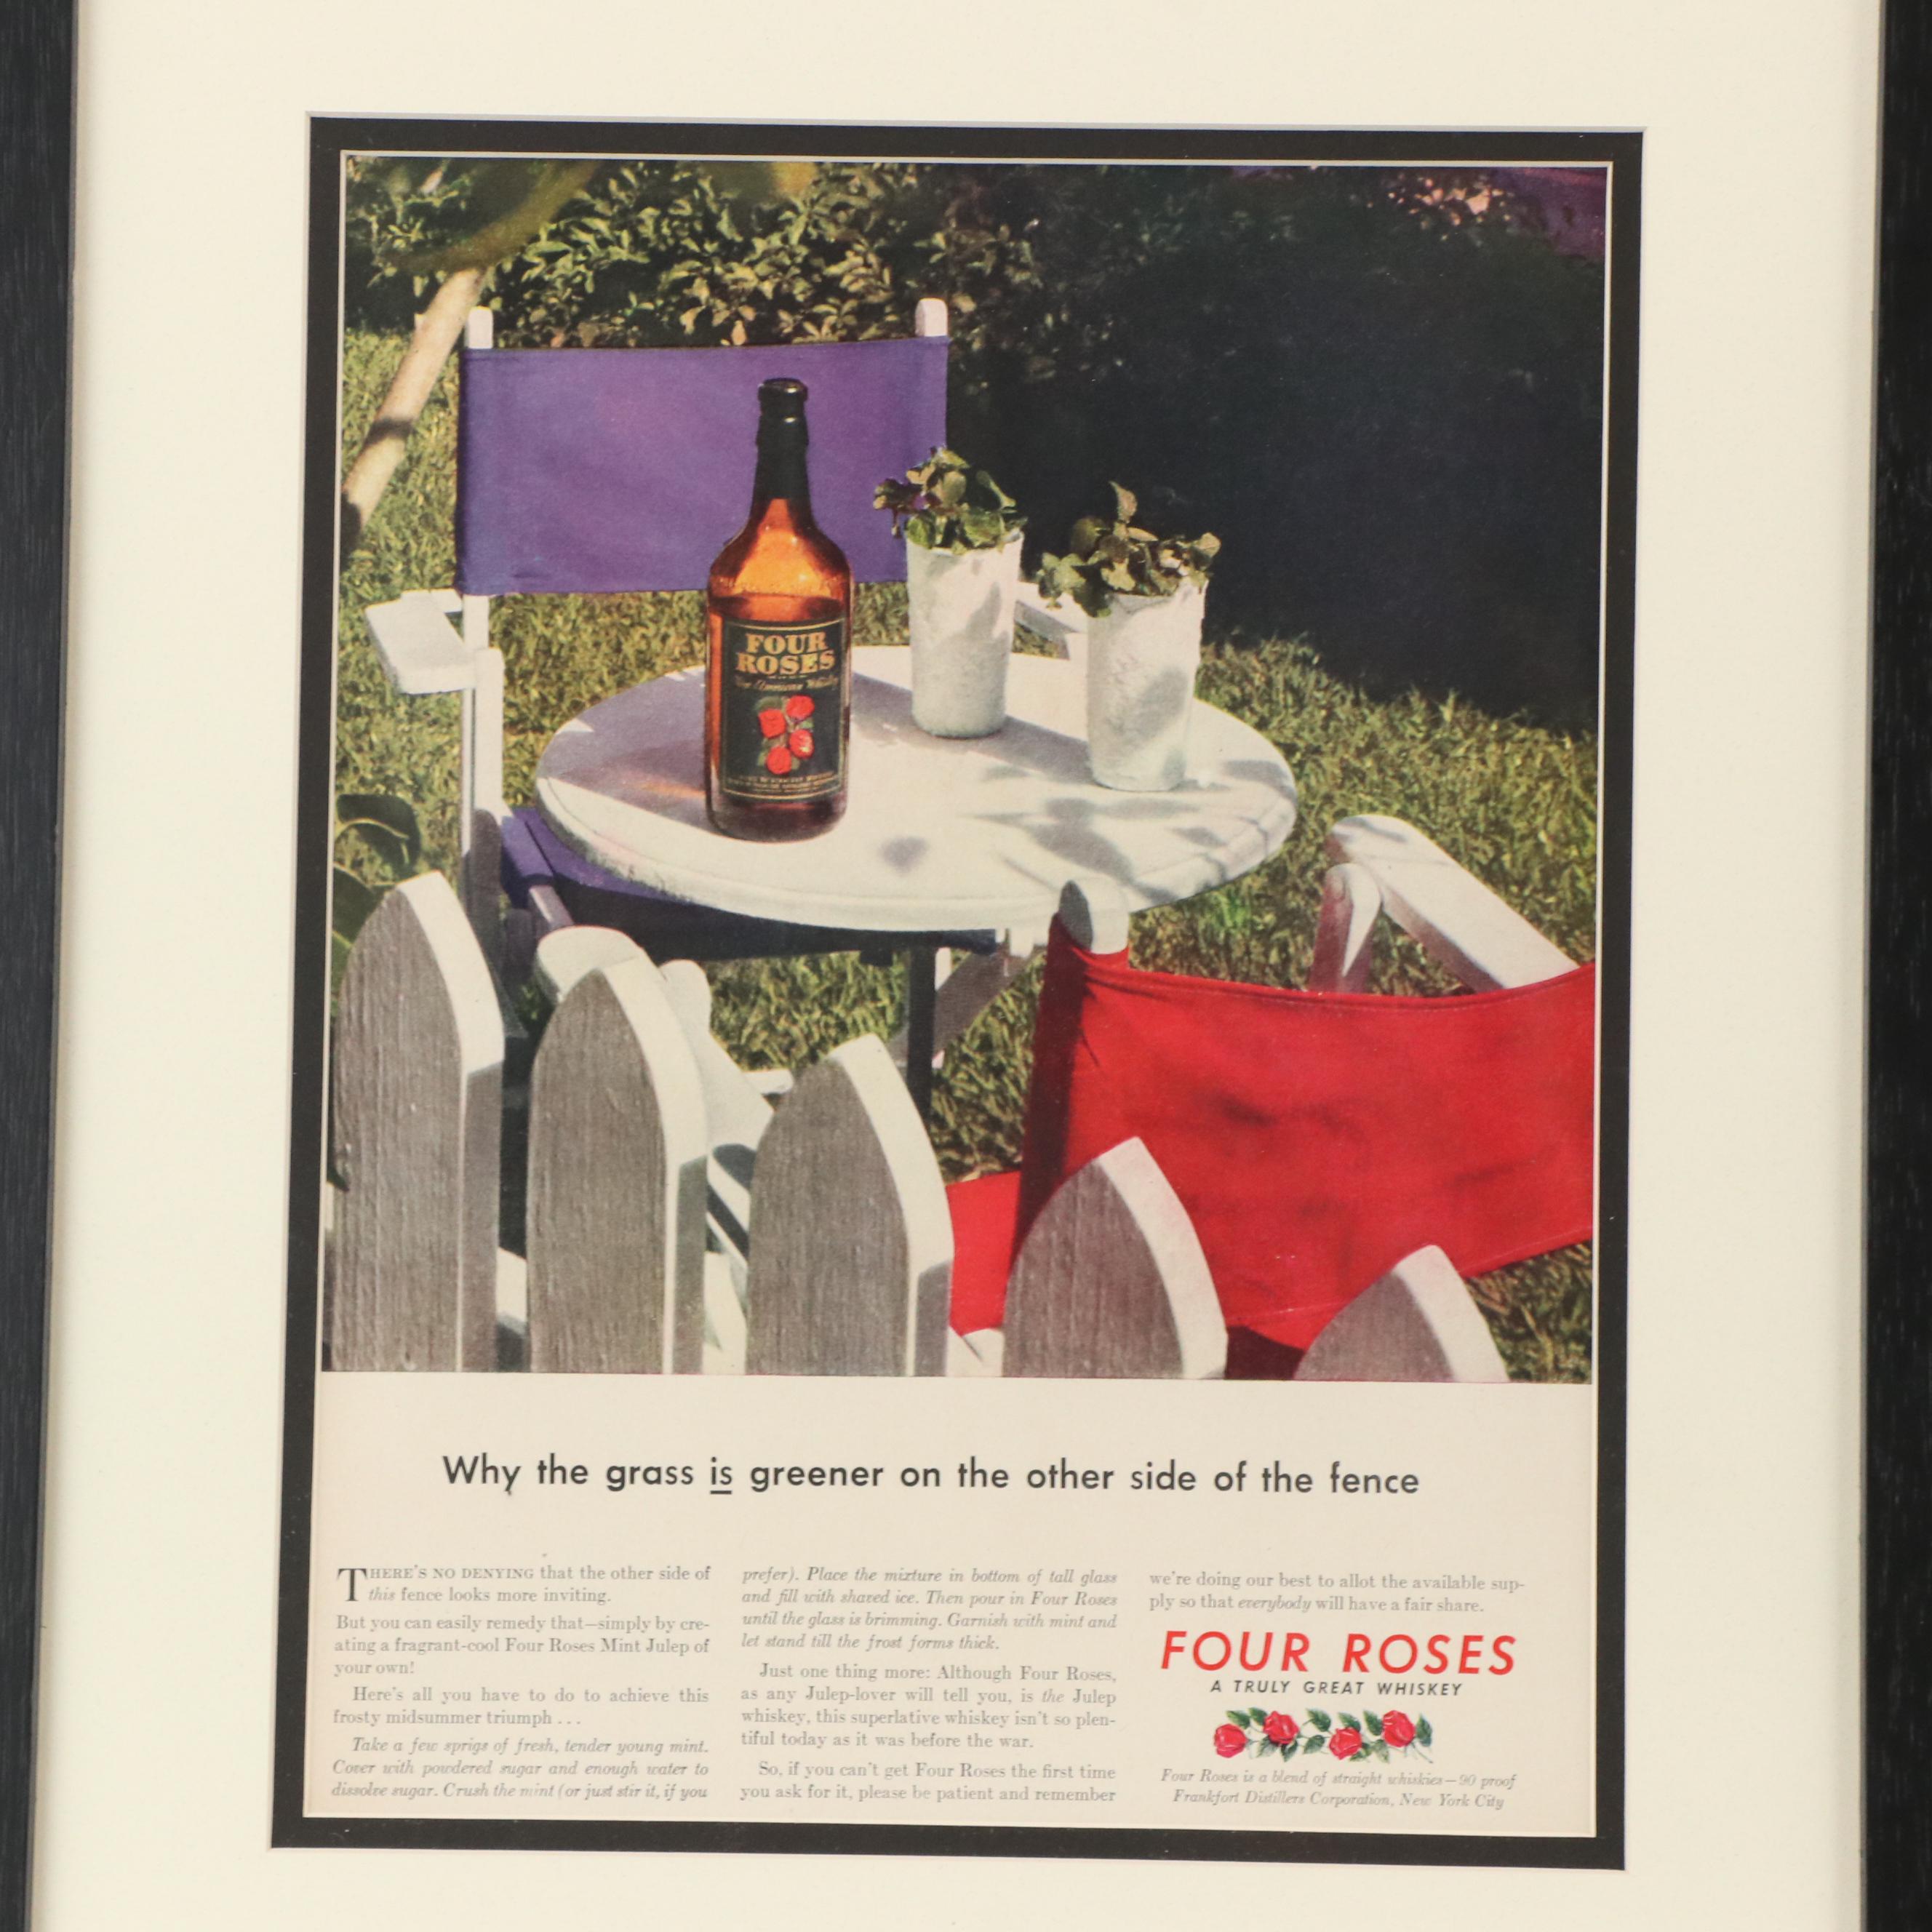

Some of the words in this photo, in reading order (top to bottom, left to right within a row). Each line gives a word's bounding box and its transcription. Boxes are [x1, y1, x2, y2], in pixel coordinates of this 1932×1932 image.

[746, 631, 828, 654] FOUR
[736, 650, 835, 675] ROSES
[442, 1452, 522, 1495] Why
[537, 1452, 589, 1485] the
[606, 1465, 694, 1493] grass
[709, 1456, 733, 1496] is
[749, 1466, 884, 1493] greener
[900, 1467, 941, 1488] on
[957, 1455, 1010, 1489] the
[1026, 1457, 1114, 1490] other
[1130, 1458, 1197, 1491] side
[1213, 1460, 1248, 1492] of
[1261, 1460, 1313, 1493] the
[1329, 1461, 1419, 1494] fence
[432, 1568, 456, 1579] NO
[461, 1568, 534, 1579] DENYING
[540, 1565, 573, 1579] that
[579, 1565, 606, 1580] the
[610, 1565, 654, 1580] other
[658, 1565, 690, 1581] side
[806, 1566, 848, 1581] Place
[854, 1566, 877, 1581] the
[971, 1568, 1020, 1583] bottom
[1049, 1568, 1074, 1584] tall
[1079, 1569, 1118, 1587] glass
[1149, 1570, 1191, 1586] we're
[1196, 1570, 1242, 1590] doing
[1245, 1576, 1274, 1586] our
[1278, 1571, 1312, 1587] best
[1339, 1573, 1376, 1589] allot
[1381, 1573, 1408, 1589] the
[1412, 1574, 1485, 1590] available
[1490, 1580, 1525, 1594] sup-
[368, 1586, 396, 1601] this
[401, 1586, 443, 1601] fence
[449, 1586, 490, 1602] looks
[497, 1592, 538, 1602] more
[543, 1586, 612, 1606] inviting.
[741, 1588, 772, 1603] and
[926, 1589, 964, 1605] Then
[969, 1595, 1005, 1609] pour
[1030, 1590, 1069, 1605] Four
[1074, 1591, 1118, 1606] Roses
[1149, 1592, 1175, 1612] ply
[1200, 1593, 1234, 1608] that
[1237, 1594, 1312, 1613] everybody
[1314, 1595, 1344, 1610] will
[1348, 1595, 1387, 1611] have
[1404, 1597, 1434, 1611] fair
[1437, 1597, 1484, 1612] share.
[337, 1614, 365, 1629] But
[370, 1619, 400, 1632] you
[404, 1619, 432, 1629] can
[436, 1614, 482, 1633] easily
[486, 1615, 546, 1633] remedy
[742, 1610, 778, 1625] until
[781, 1610, 805, 1626] the
[807, 1610, 845, 1629] glass
[946, 1612, 1007, 1627] Garnish
[1050, 1613, 1085, 1628] mint
[1087, 1613, 1118, 1629] and
[335, 1637, 376, 1652] ating
[395, 1637, 500, 1656] fragrant-cool
[505, 1637, 545, 1653] Four
[548, 1637, 595, 1653] Roses
[600, 1637, 641, 1653] Mint
[645, 1637, 690, 1657] Julep
[741, 1632, 760, 1648] let
[765, 1633, 807, 1648] stand
[837, 1633, 861, 1648] the
[865, 1634, 903, 1652] frost
[907, 1634, 954, 1653] forms
[1160, 1630, 1310, 1672] FOUR
[1342, 1633, 1517, 1676] ROSES
[334, 1664, 372, 1677] your
[375, 1661, 415, 1674] own!
[759, 1662, 794, 1677] Just
[799, 1668, 829, 1678] one
[835, 1663, 878, 1682] thing
[885, 1669, 930, 1679] more:
[936, 1664, 1012, 1683] Although
[1019, 1665, 1060, 1680] Four
[1066, 1666, 1117, 1682] Roses,
[412, 1686, 433, 1701] all
[441, 1691, 471, 1705] you
[481, 1686, 520, 1702] have
[609, 1687, 670, 1703] achieve
[679, 1687, 709, 1703] this
[766, 1690, 797, 1704] any
[805, 1685, 897, 1705] Julep-lover
[904, 1687, 933, 1702] will
[943, 1687, 968, 1702] tell
[977, 1692, 1012, 1706] you,
[1041, 1688, 1065, 1703] the
[1072, 1688, 1117, 1708] Julep
[1210, 1679, 1222, 1693] A
[1233, 1680, 1290, 1693] TRULY
[1303, 1680, 1365, 1695] GREAT
[1377, 1682, 1463, 1696] WHISKEY
[333, 1709, 381, 1728] frosty
[386, 1709, 482, 1724] midsummer
[487, 1709, 552, 1728] triumph
[741, 1707, 811, 1727] whiskey,
[815, 1708, 846, 1723] this
[851, 1709, 940, 1728] superlative
[944, 1709, 1010, 1728] whiskey
[353, 1736, 388, 1752] Take
[444, 1737, 489, 1756] sprigs
[564, 1737, 612, 1752] tender
[616, 1743, 664, 1757] young
[741, 1730, 775, 1746] tiful
[781, 1731, 827, 1749] today
[875, 1736, 905, 1747] was
[910, 1731, 961, 1747] before
[967, 1732, 993, 1748] the
[999, 1738, 1034, 1748] war.
[421, 1759, 493, 1778] powdered
[499, 1765, 543, 1776] sugar
[548, 1760, 579, 1775] and
[584, 1760, 638, 1779] enough
[759, 1760, 783, 1776] So,
[804, 1766, 834, 1779] you
[839, 1762, 879, 1776] can't
[885, 1764, 909, 1779] get
[915, 1762, 955, 1777] Four
[959, 1763, 1006, 1778] Roses
[1010, 1763, 1037, 1779] the
[1042, 1763, 1074, 1779] first
[1079, 1764, 1116, 1779] time
[1160, 1768, 1195, 1781] Four
[1199, 1768, 1238, 1782] Roses
[1273, 1770, 1309, 1781] blend
[1334, 1771, 1382, 1788] straight
[1480, 1774, 1517, 1790] proof
[443, 1782, 489, 1797] Crush
[493, 1782, 516, 1797] the
[584, 1783, 613, 1801] just
[616, 1783, 642, 1798] stir
[679, 1788, 708, 1802] you
[739, 1788, 770, 1801] you
[775, 1783, 802, 1798] ask
[807, 1784, 831, 1799] for
[836, 1784, 853, 1800] it,
[858, 1784, 907, 1803] please
[936, 1785, 994, 1803] patient
[999, 1786, 1029, 1800] and
[1034, 1786, 1117, 1802] remember
[1173, 1789, 1240, 1806] Frankfort
[1244, 1789, 1306, 1805] Distillers
[1399, 1792, 1432, 1807] New
[1437, 1792, 1470, 1809] York
[1474, 1794, 1506, 1811] City
